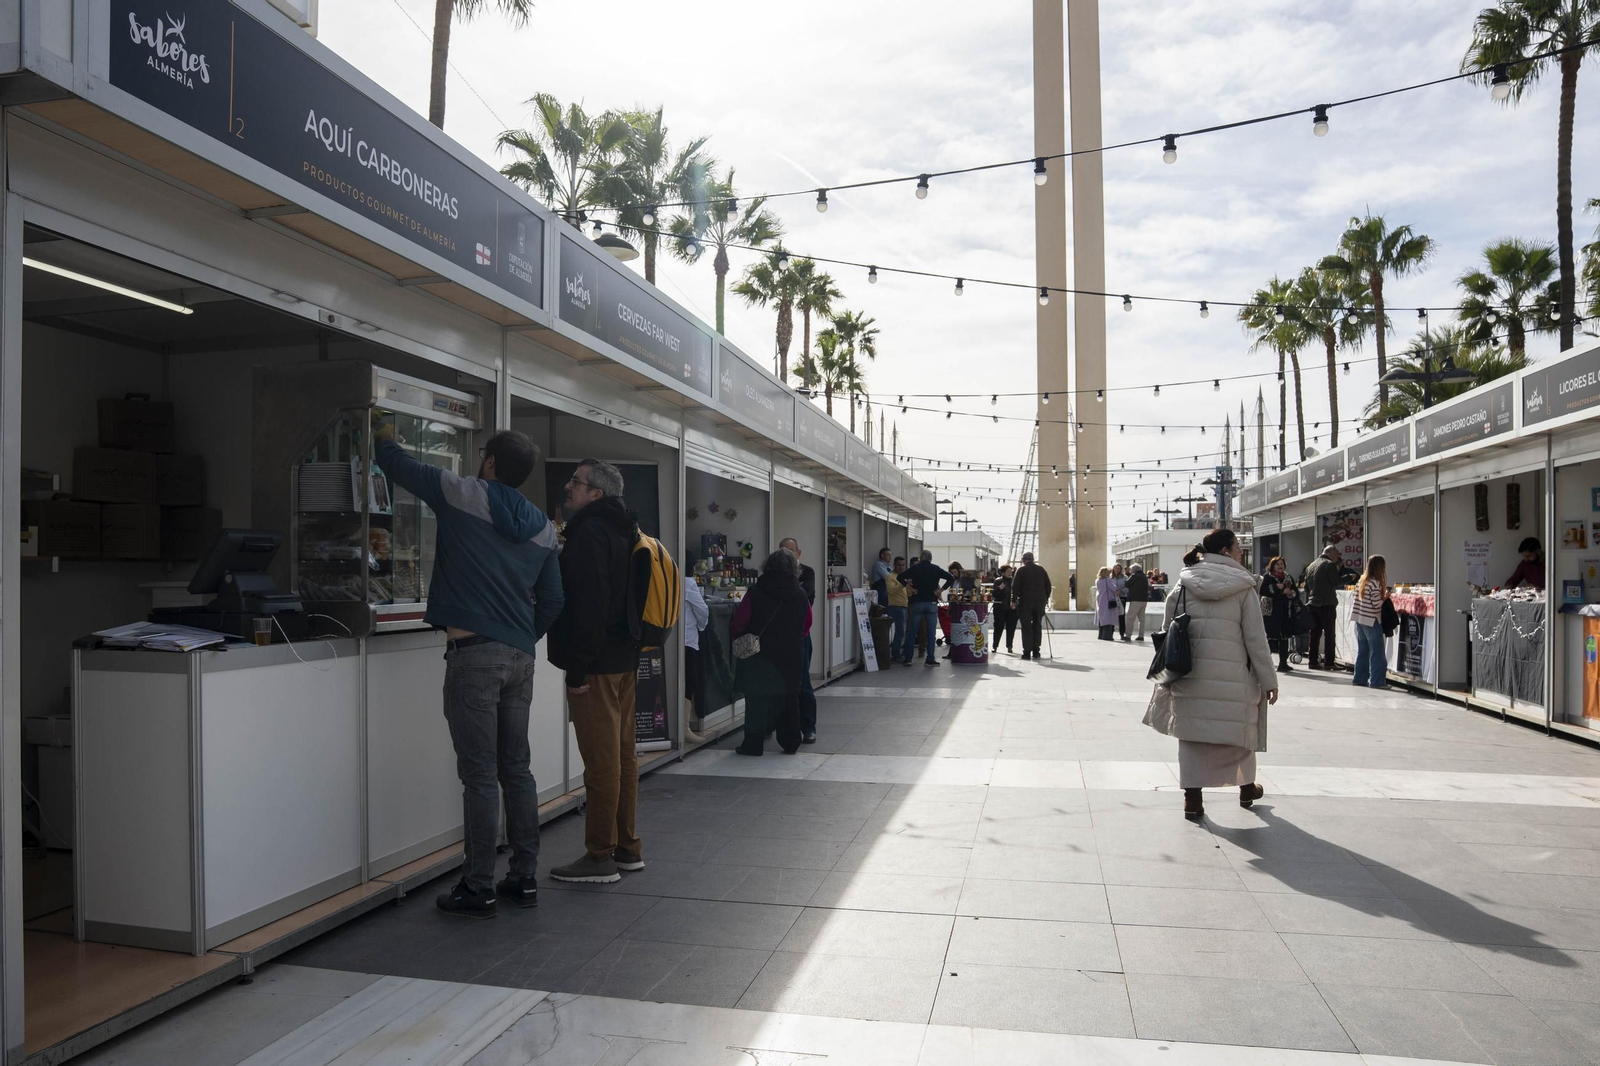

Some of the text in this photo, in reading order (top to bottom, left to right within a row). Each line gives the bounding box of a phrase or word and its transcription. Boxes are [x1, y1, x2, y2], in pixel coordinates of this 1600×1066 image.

[128, 12, 210, 84] Sabores
[147, 55, 194, 89] ALMERÍA
[236, 117, 245, 140] 2
[304, 109, 459, 220] AQUÍ CARBONERAS
[303, 161, 457, 252] PRODUCTOS GOURMET DE ALMERÍA
[617, 303, 681, 354] CERVEZAS FAR WEST
[1559, 374, 1587, 395] LICORES
[1588, 371, 1597, 386] EL
[1432, 424, 1452, 439] JAMONES
[1452, 418, 1467, 433] PEDRO
[1466, 409, 1487, 428] CASTAÑO
[1339, 531, 1363, 541] GOO
[1347, 518, 1362, 527] BE
[1345, 545, 1364, 554] BIO
